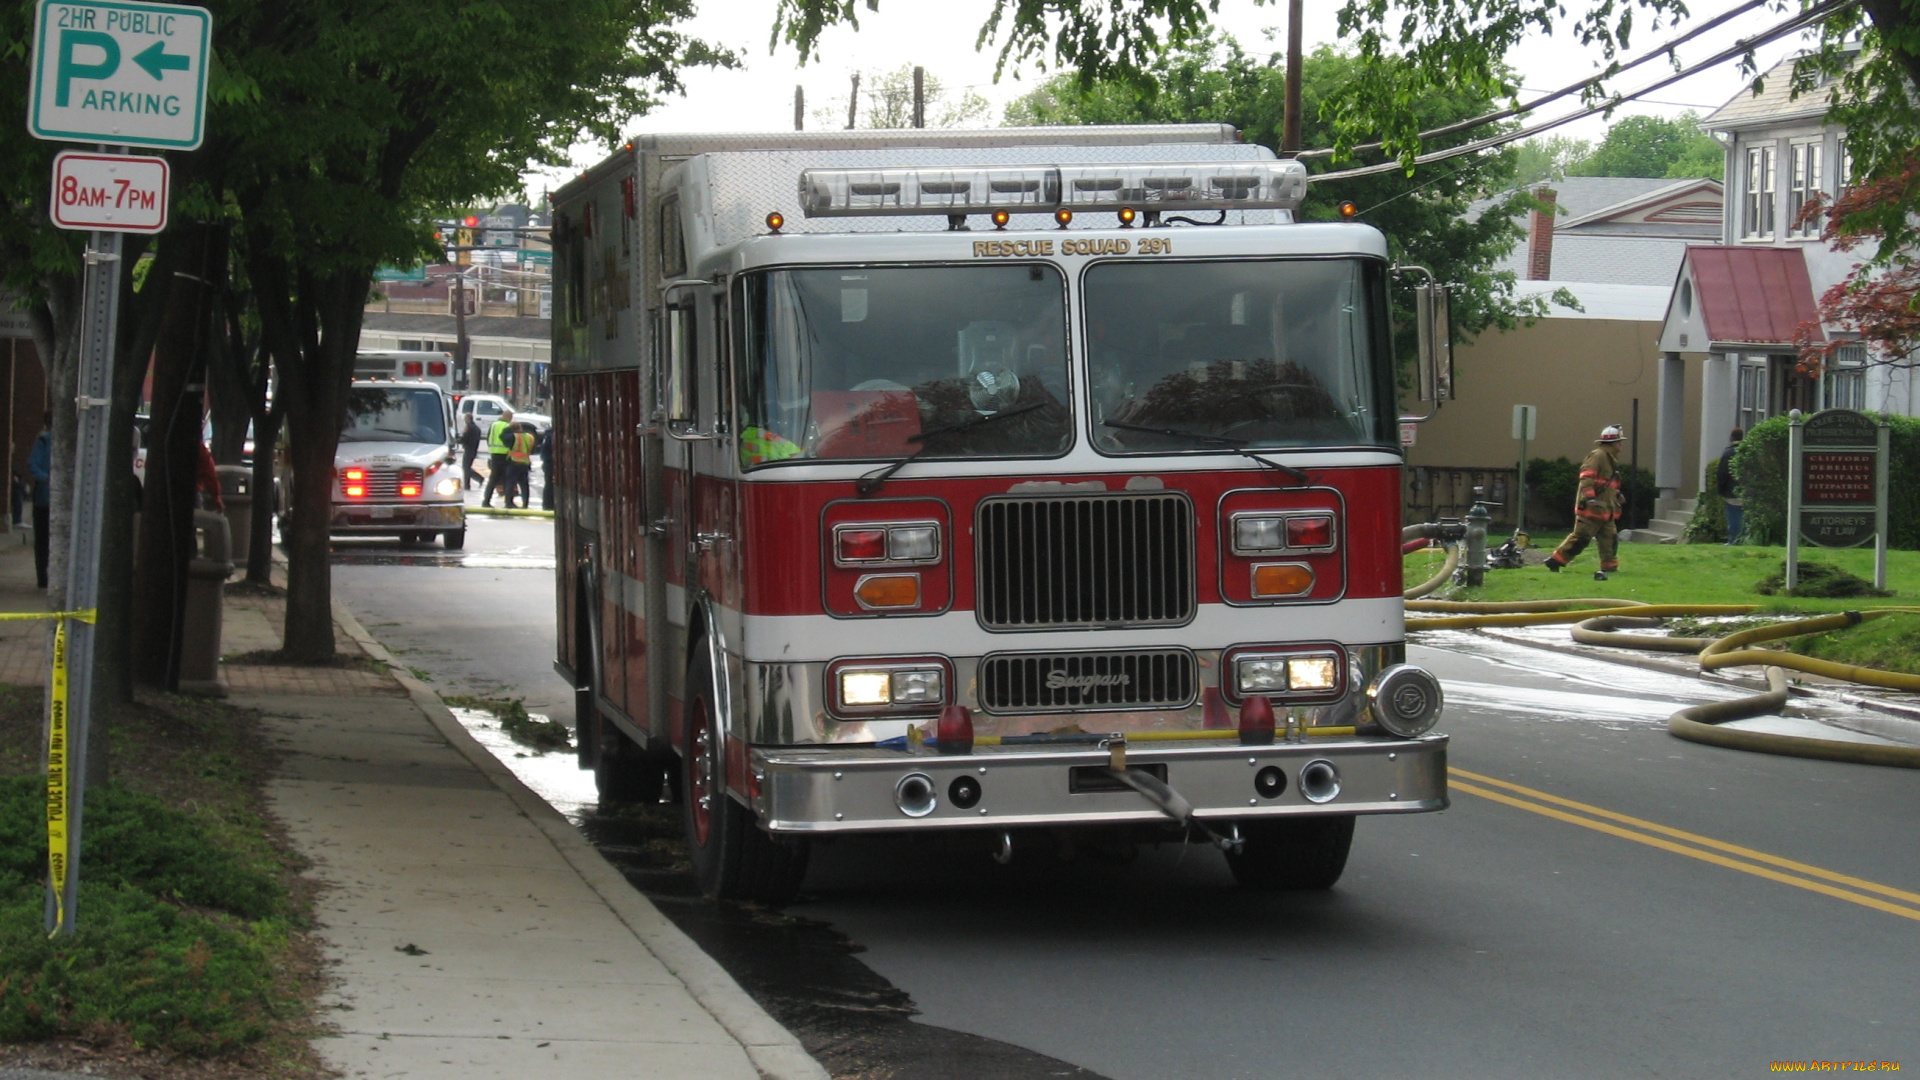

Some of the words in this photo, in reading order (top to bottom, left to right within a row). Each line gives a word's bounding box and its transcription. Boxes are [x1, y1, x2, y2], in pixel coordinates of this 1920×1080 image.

[57, 7, 96, 29] 2HR
[106, 11, 176, 36] PUBLIC
[61, 176, 155, 210] 8AM-7PM
[973, 240, 1054, 257] RESCUE
[1062, 238, 1131, 256] SQUAD
[1138, 238, 1172, 254] 291
[1810, 516, 1866, 525] ATTORNEYS
[1820, 526, 1831, 535] AT
[1835, 526, 1857, 535] LAW
[1045, 669, 1131, 695] Seagrave
[51, 733, 63, 750] NOT
[48, 752, 63, 765] DO
[48, 768, 63, 788] LINE
[48, 790, 63, 821] POLICE
